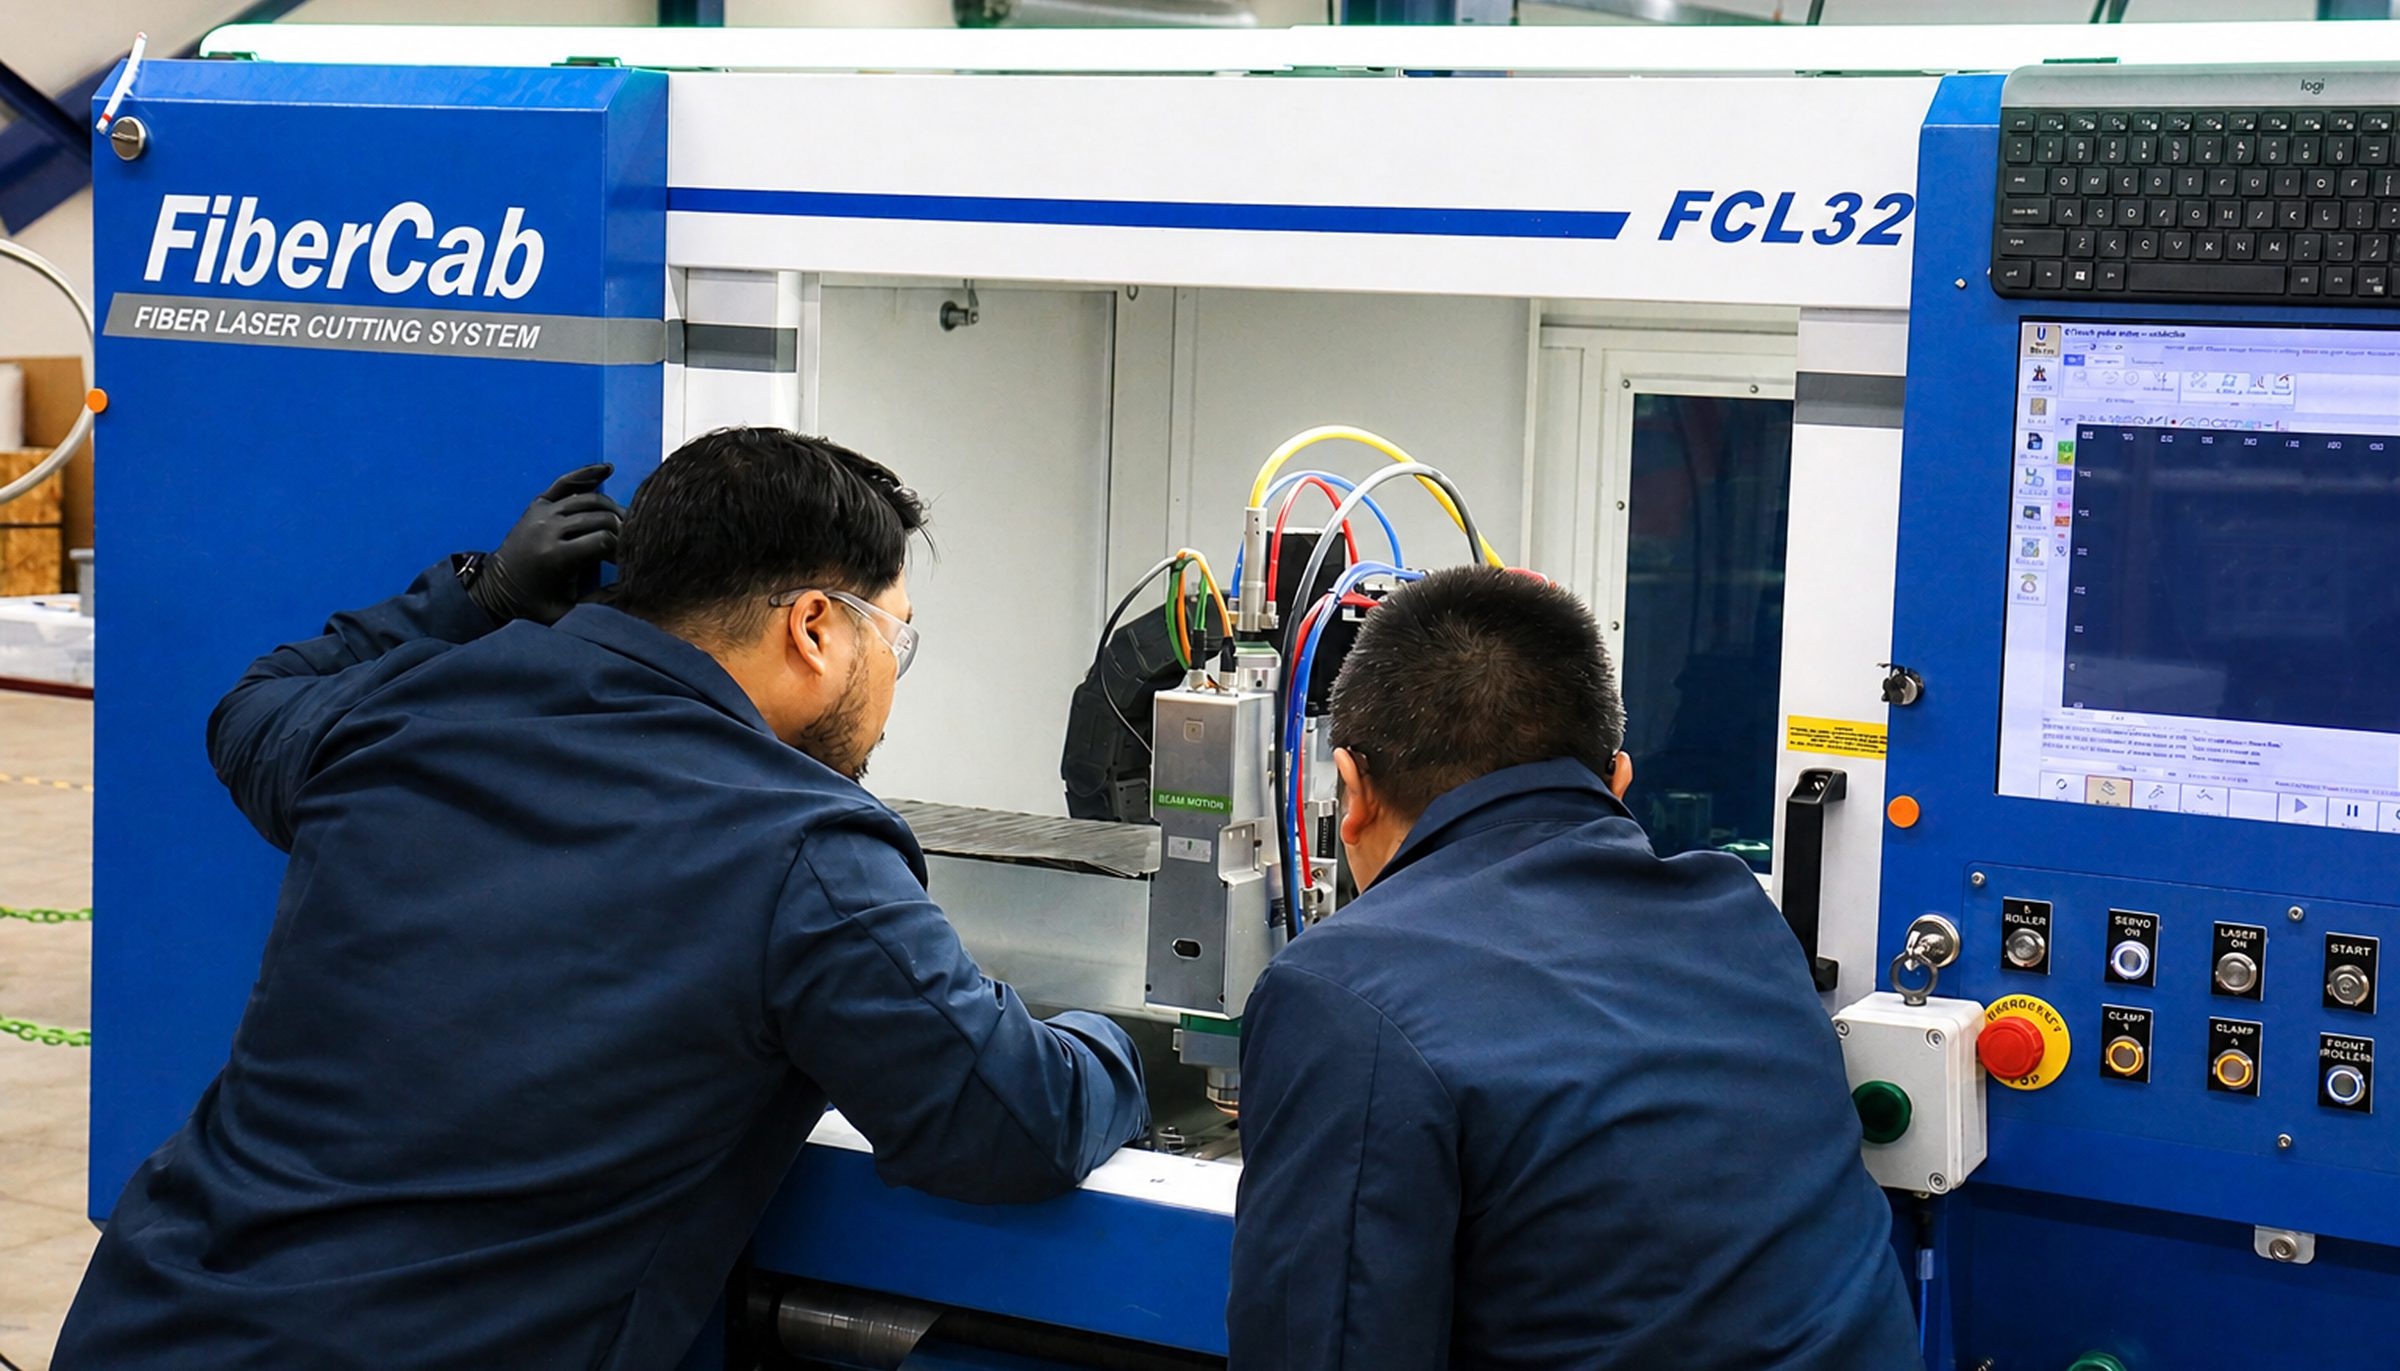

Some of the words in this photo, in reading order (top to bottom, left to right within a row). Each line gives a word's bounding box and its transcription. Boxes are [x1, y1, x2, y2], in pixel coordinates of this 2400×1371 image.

[2301, 78, 2325, 95] logi
[1658, 190, 1915, 246] FCL32
[143, 194, 545, 299] FiberCab
[134, 305, 209, 333] FIBER
[215, 310, 300, 338] LASER
[307, 315, 422, 344] CUTTING
[428, 320, 541, 350] SYSTEM
[2005, 913, 2047, 926] ROLLER
[2115, 915, 2151, 929] SERVO
[2220, 928, 2257, 940] LASER
[2230, 939, 2248, 949] ON
[2330, 943, 2372, 957] START
[2108, 1010, 2145, 1023] CLAMP
[2215, 1023, 2254, 1036] CLAMP
